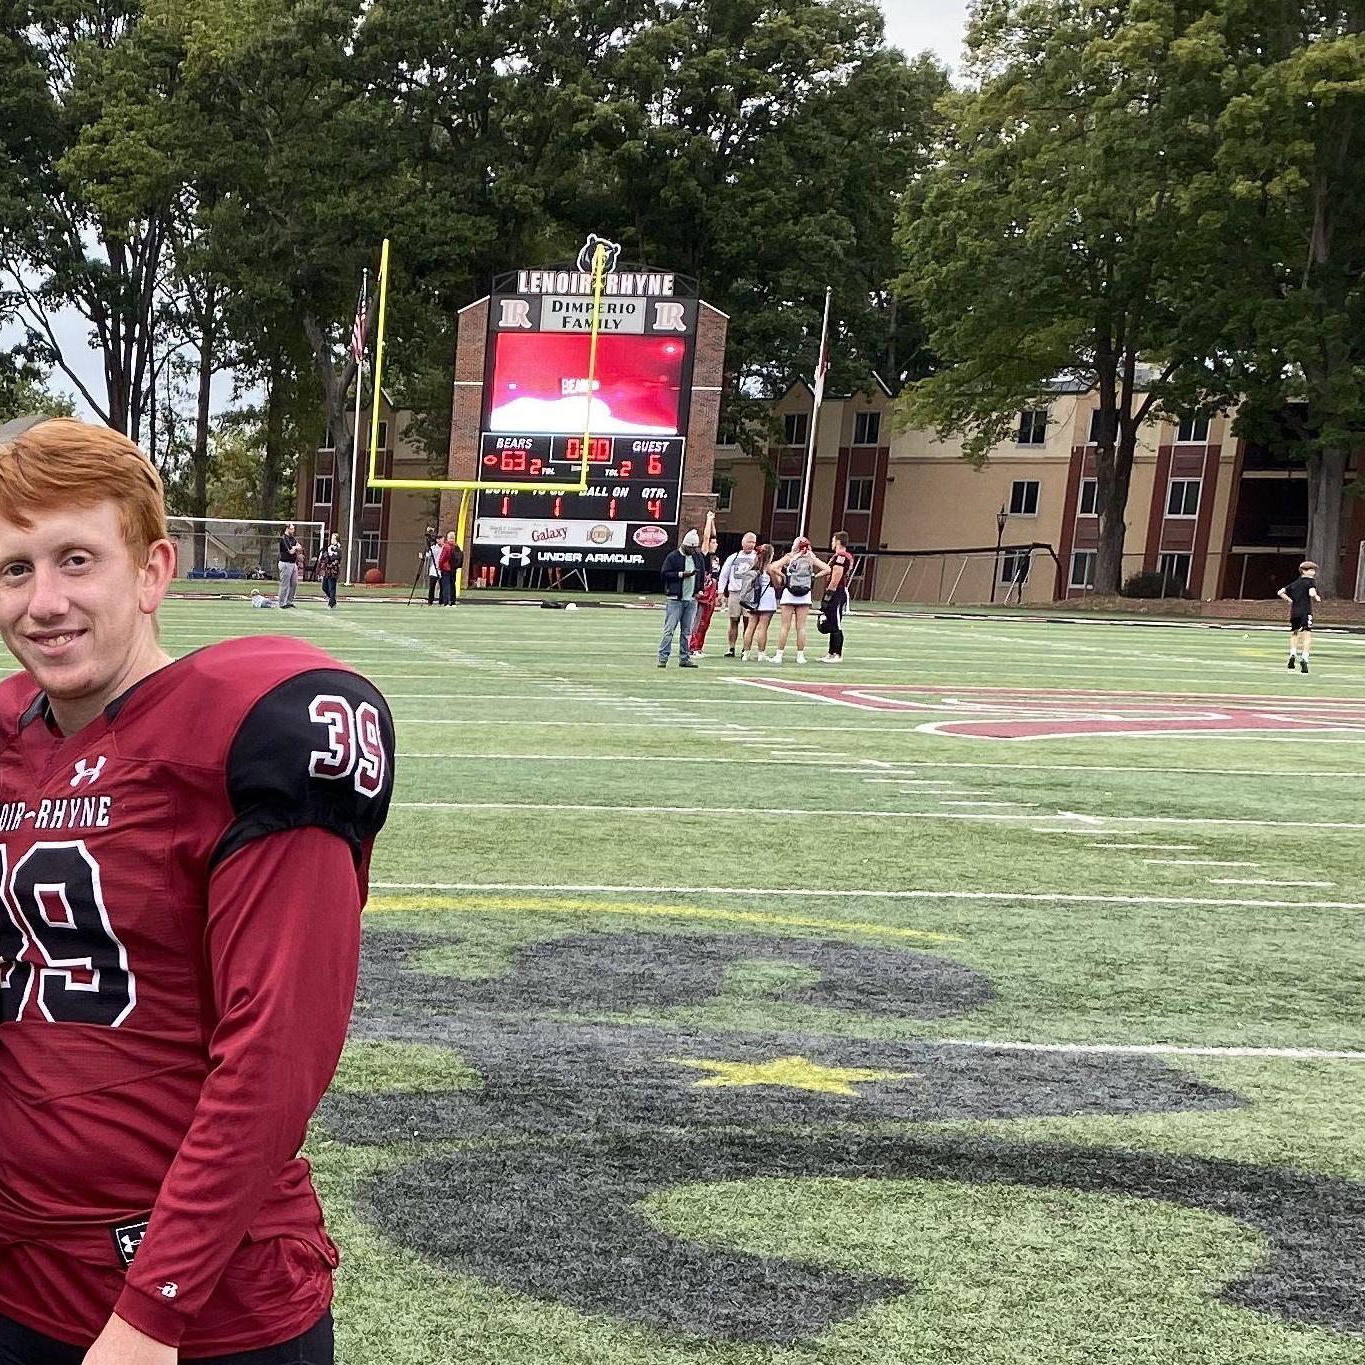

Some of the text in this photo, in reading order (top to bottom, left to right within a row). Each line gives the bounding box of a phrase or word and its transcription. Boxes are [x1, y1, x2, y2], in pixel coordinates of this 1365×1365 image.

[496, 437, 533, 449] BEARS
[632, 440, 670, 453] GUEST
[500, 450, 526, 471] 63
[529, 458, 542, 475] 2
[619, 460, 632, 477] 2
[647, 454, 662, 475] 6
[612, 486, 630, 498] ON
[641, 487, 668, 499] QTR.
[647, 499, 662, 520] 4
[531, 526, 568, 542] Galaxy
[537, 551, 583, 563] UNDER
[308, 694, 386, 799] 39
